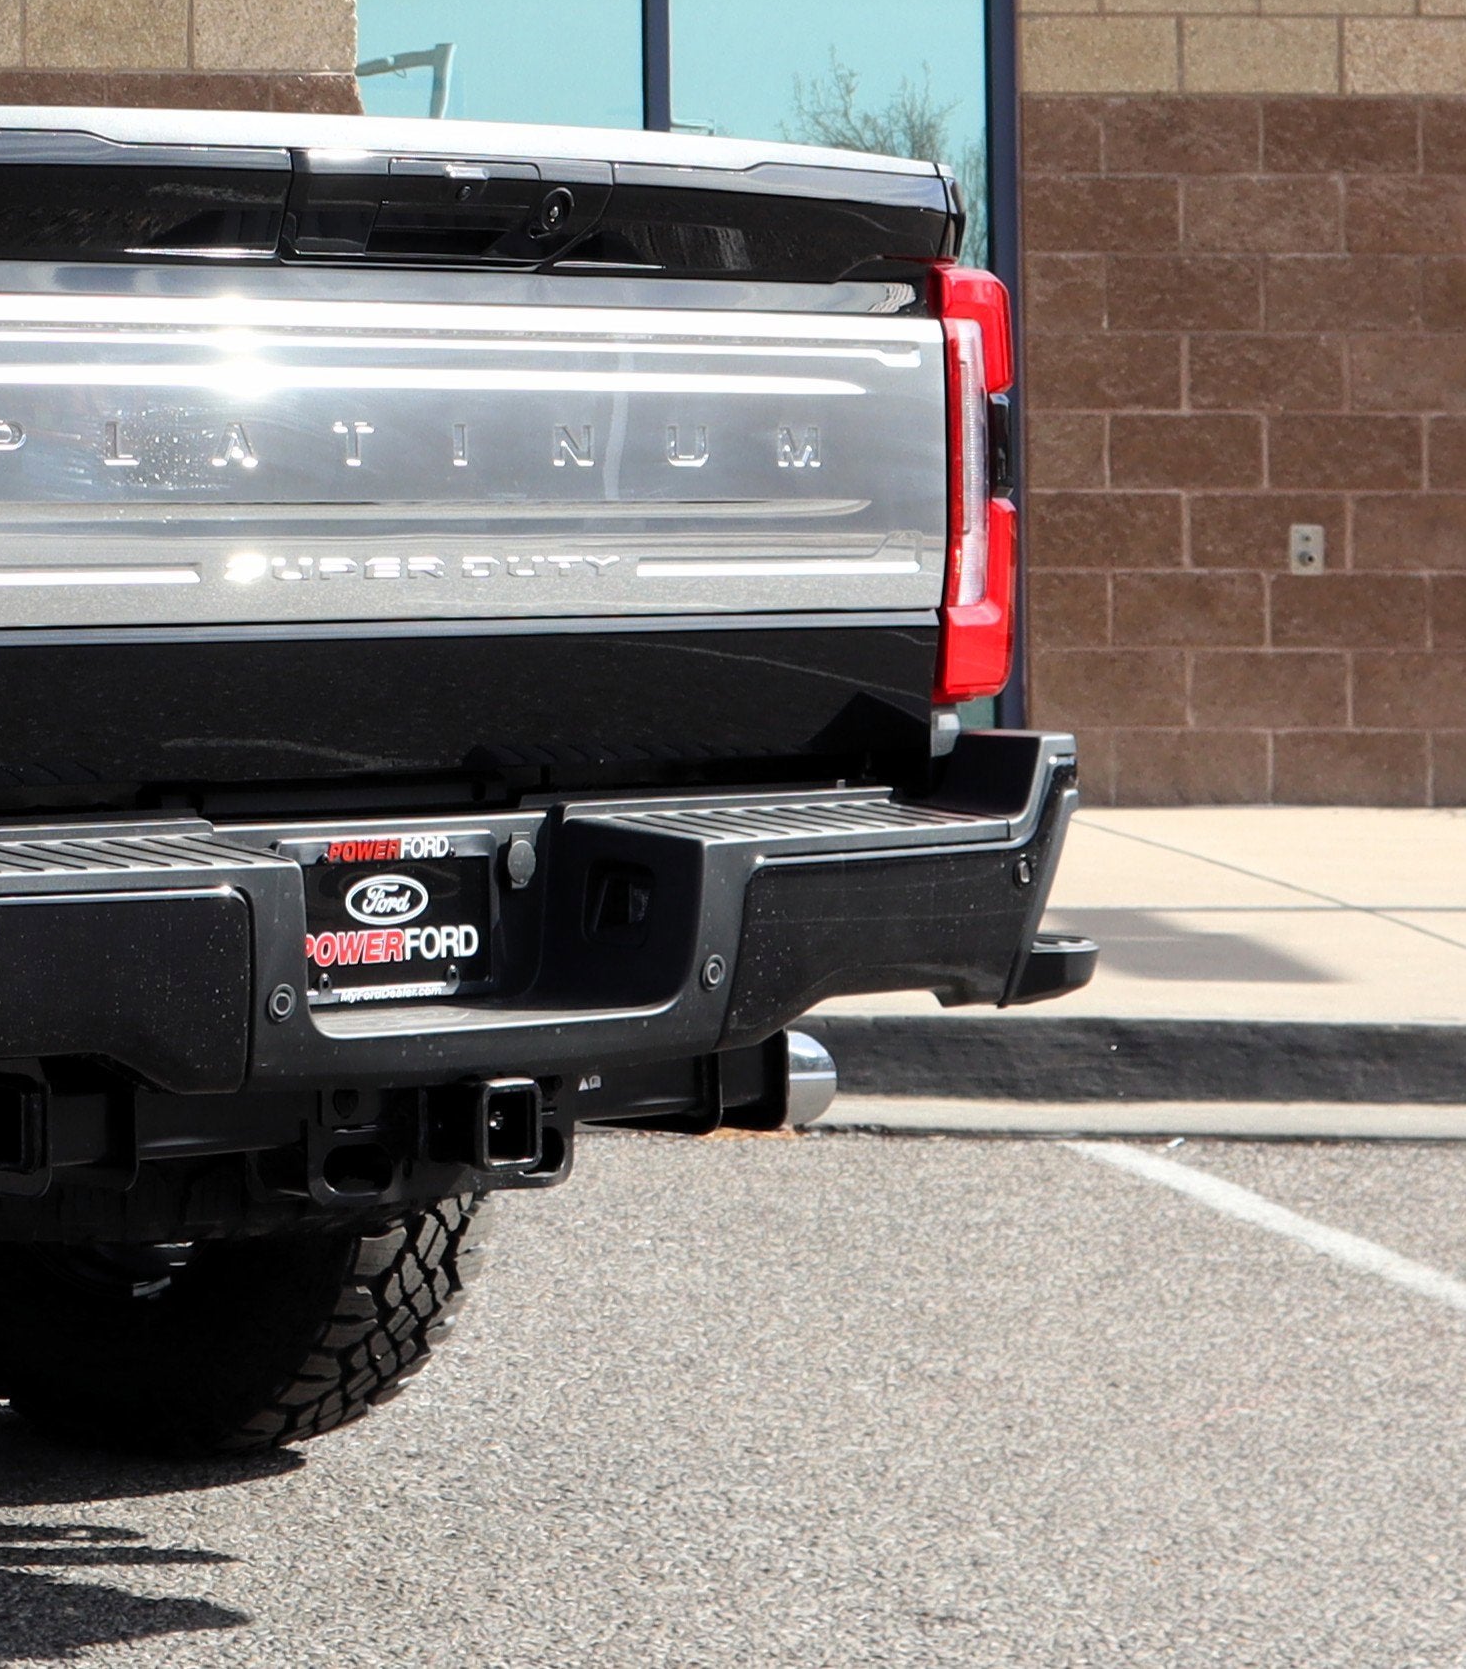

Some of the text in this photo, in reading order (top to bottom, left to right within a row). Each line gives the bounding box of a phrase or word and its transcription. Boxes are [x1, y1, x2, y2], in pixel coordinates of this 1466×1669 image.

[461, 555, 622, 578] DUTY
[327, 835, 450, 862] POWERFORD
[361, 883, 411, 914] Ford
[340, 986, 443, 1004] MyFordDealer.com
